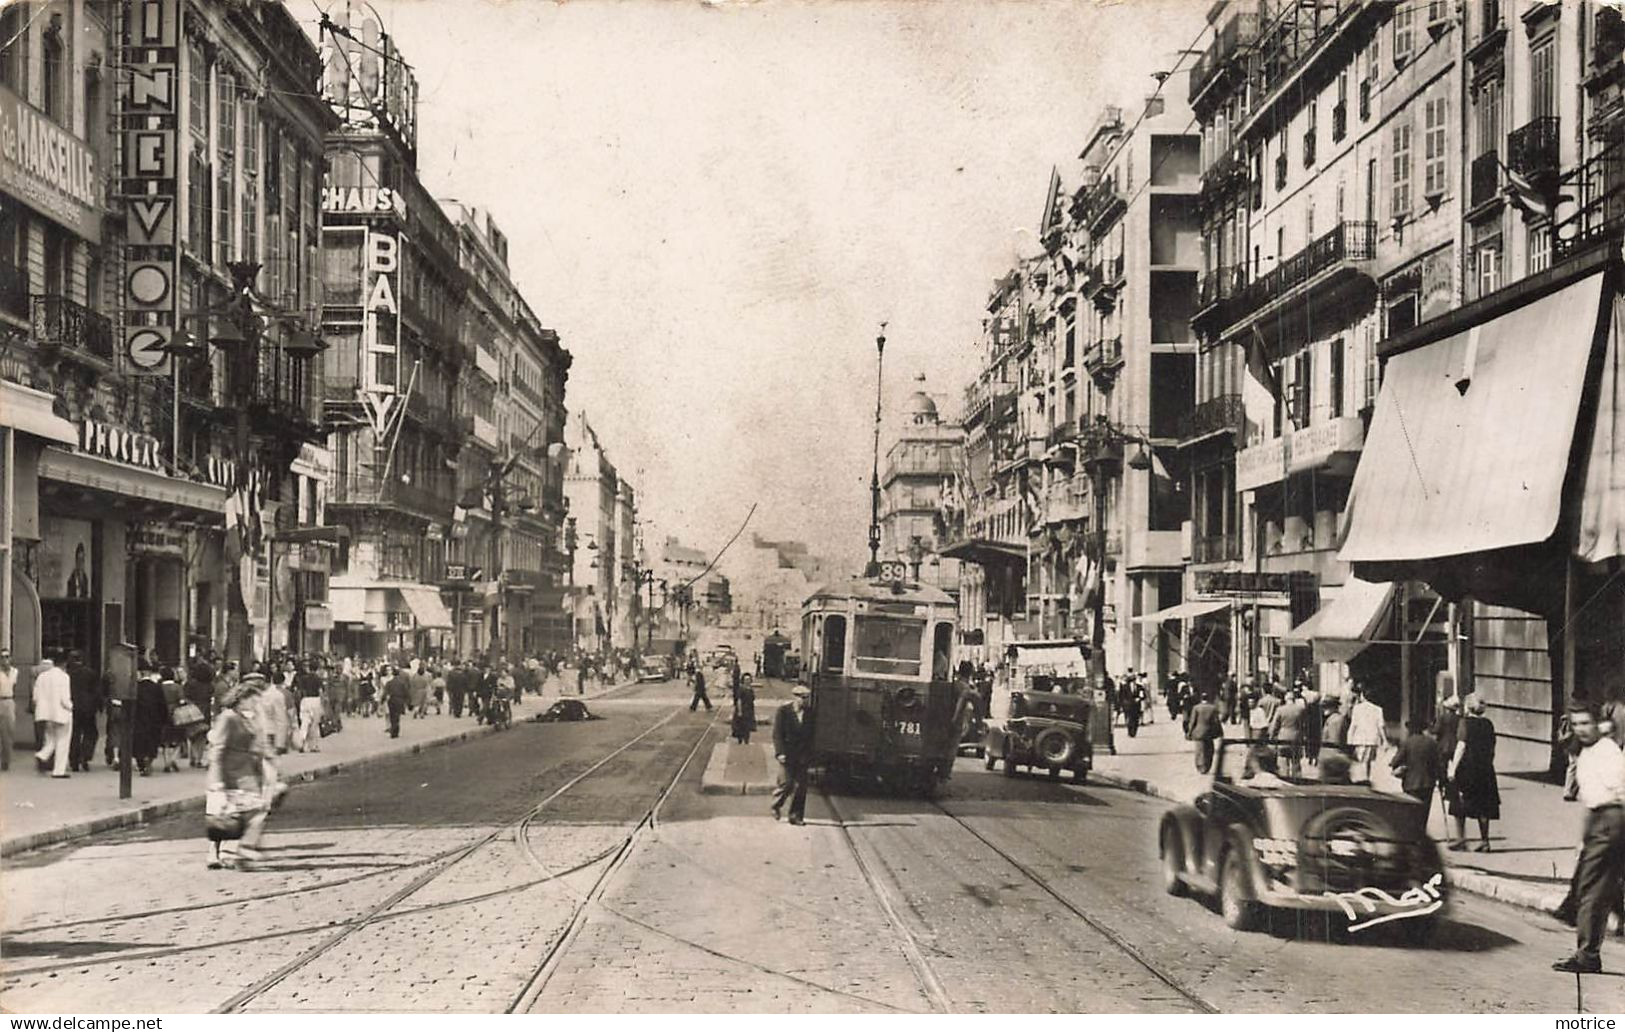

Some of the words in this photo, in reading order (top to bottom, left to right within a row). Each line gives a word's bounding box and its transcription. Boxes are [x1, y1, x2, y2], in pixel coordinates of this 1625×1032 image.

[17, 104, 95, 207] MARSEILLE
[367, 232, 397, 433] BALLY
[880, 563, 905, 582] 89
[899, 721, 920, 735] 781
